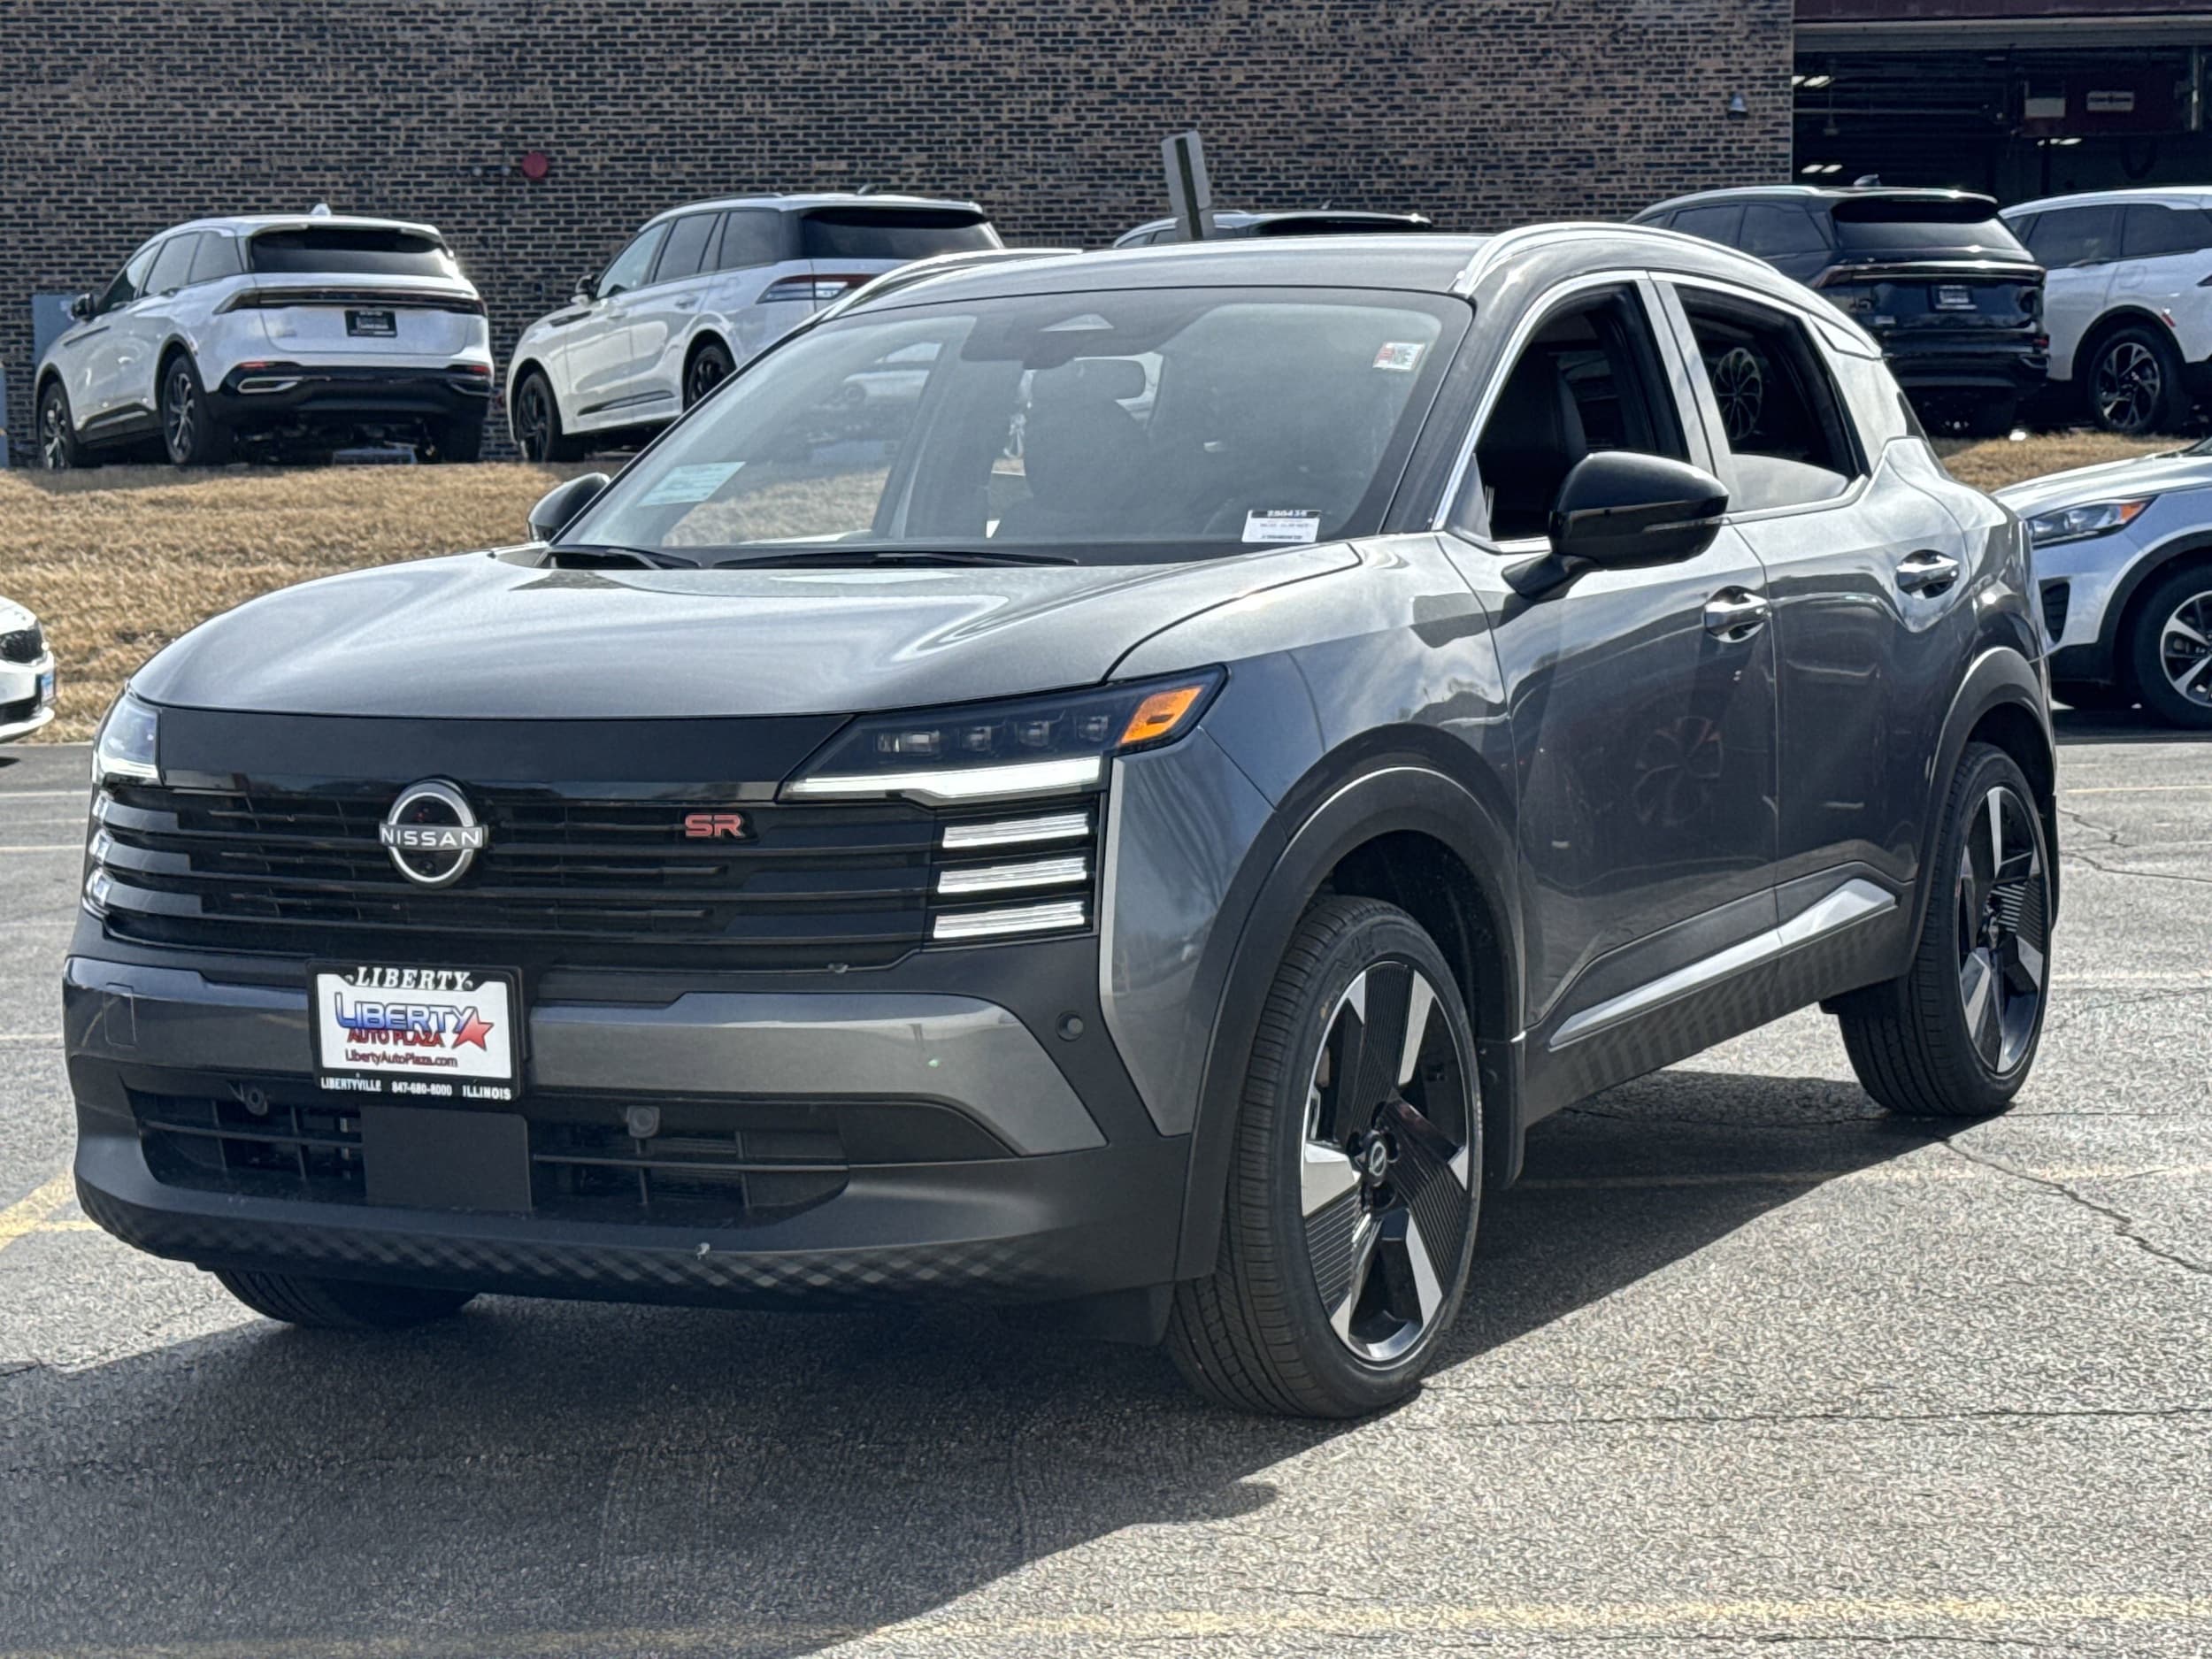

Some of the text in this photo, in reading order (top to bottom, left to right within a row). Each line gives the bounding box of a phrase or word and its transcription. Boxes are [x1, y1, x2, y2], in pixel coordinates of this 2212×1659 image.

[380, 827, 481, 846] NISSAN
[685, 814, 744, 839] SR
[357, 966, 470, 990] LIBERTY
[334, 992, 477, 1033] LIBERTY
[347, 1030, 445, 1048] AUTO PLAZA
[345, 1048, 458, 1067] LibertyAutoPlaza.com
[320, 1077, 511, 1101] LIBERTYVILLE 847-680-8000 ILLINOIS
